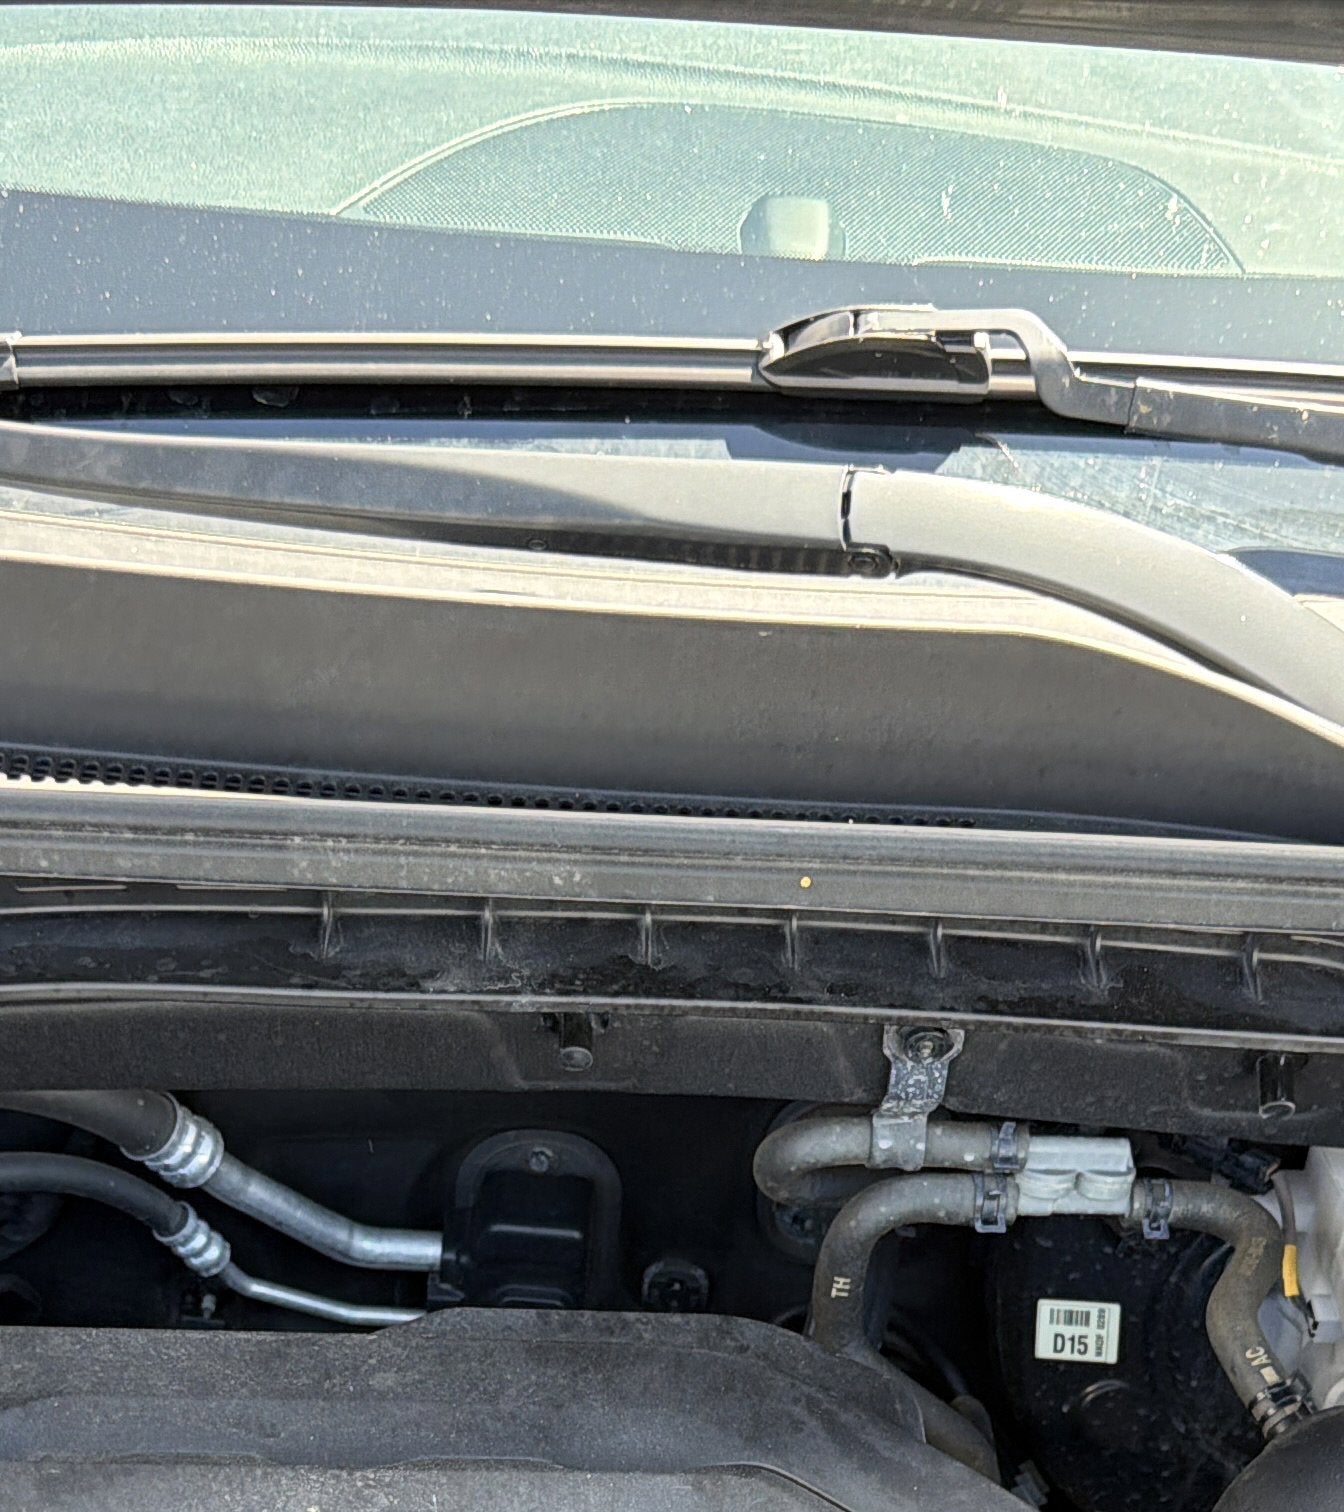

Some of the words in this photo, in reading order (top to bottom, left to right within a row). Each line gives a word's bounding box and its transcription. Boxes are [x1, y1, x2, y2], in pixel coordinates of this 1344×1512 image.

[830, 1276, 851, 1299] TH
[1053, 1333, 1089, 1356] D15
[1245, 1346, 1272, 1367] AC
